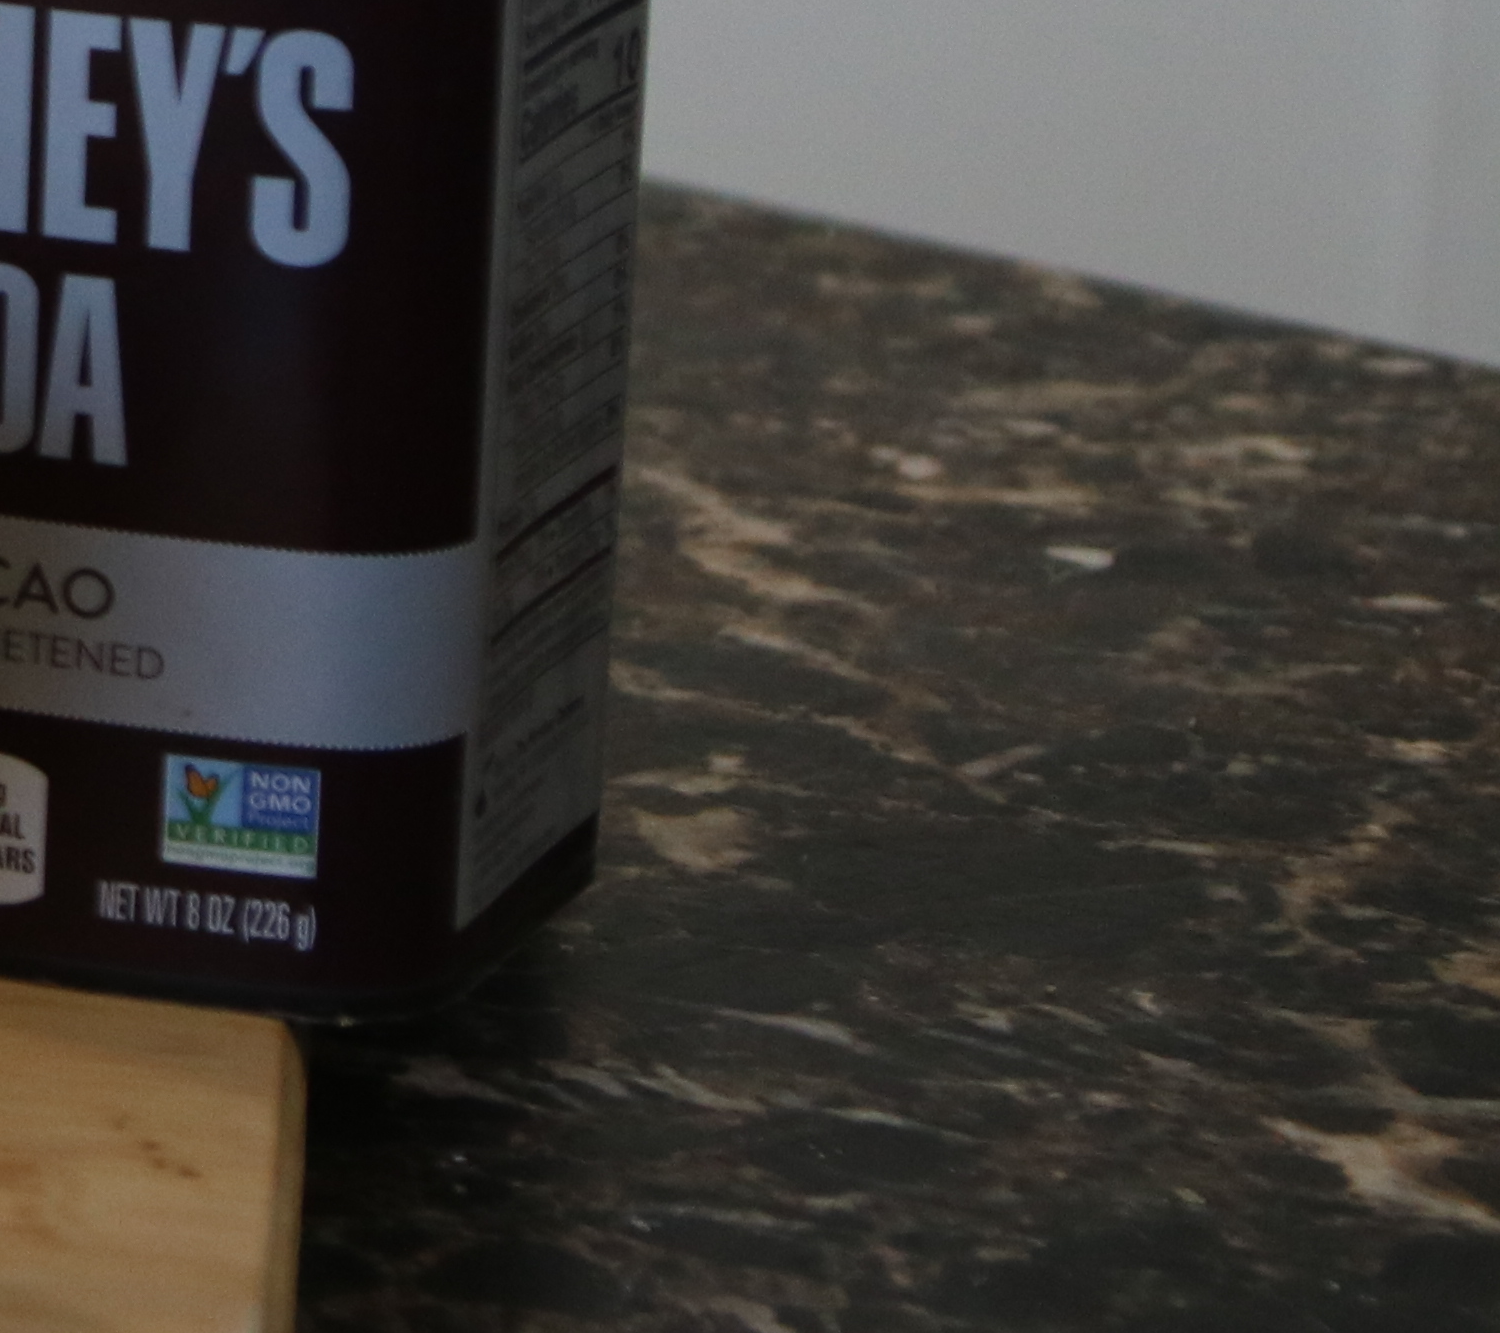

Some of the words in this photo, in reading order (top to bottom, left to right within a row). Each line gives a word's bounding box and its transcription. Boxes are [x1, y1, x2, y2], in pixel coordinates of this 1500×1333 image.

[249, 771, 312, 794] NON
[248, 791, 313, 815] GMO
[175, 823, 311, 855] VERIFIED
[95, 879, 140, 923] NET
[144, 885, 182, 928] WT
[186, 890, 201, 931] 8
[207, 893, 238, 935] OZ
